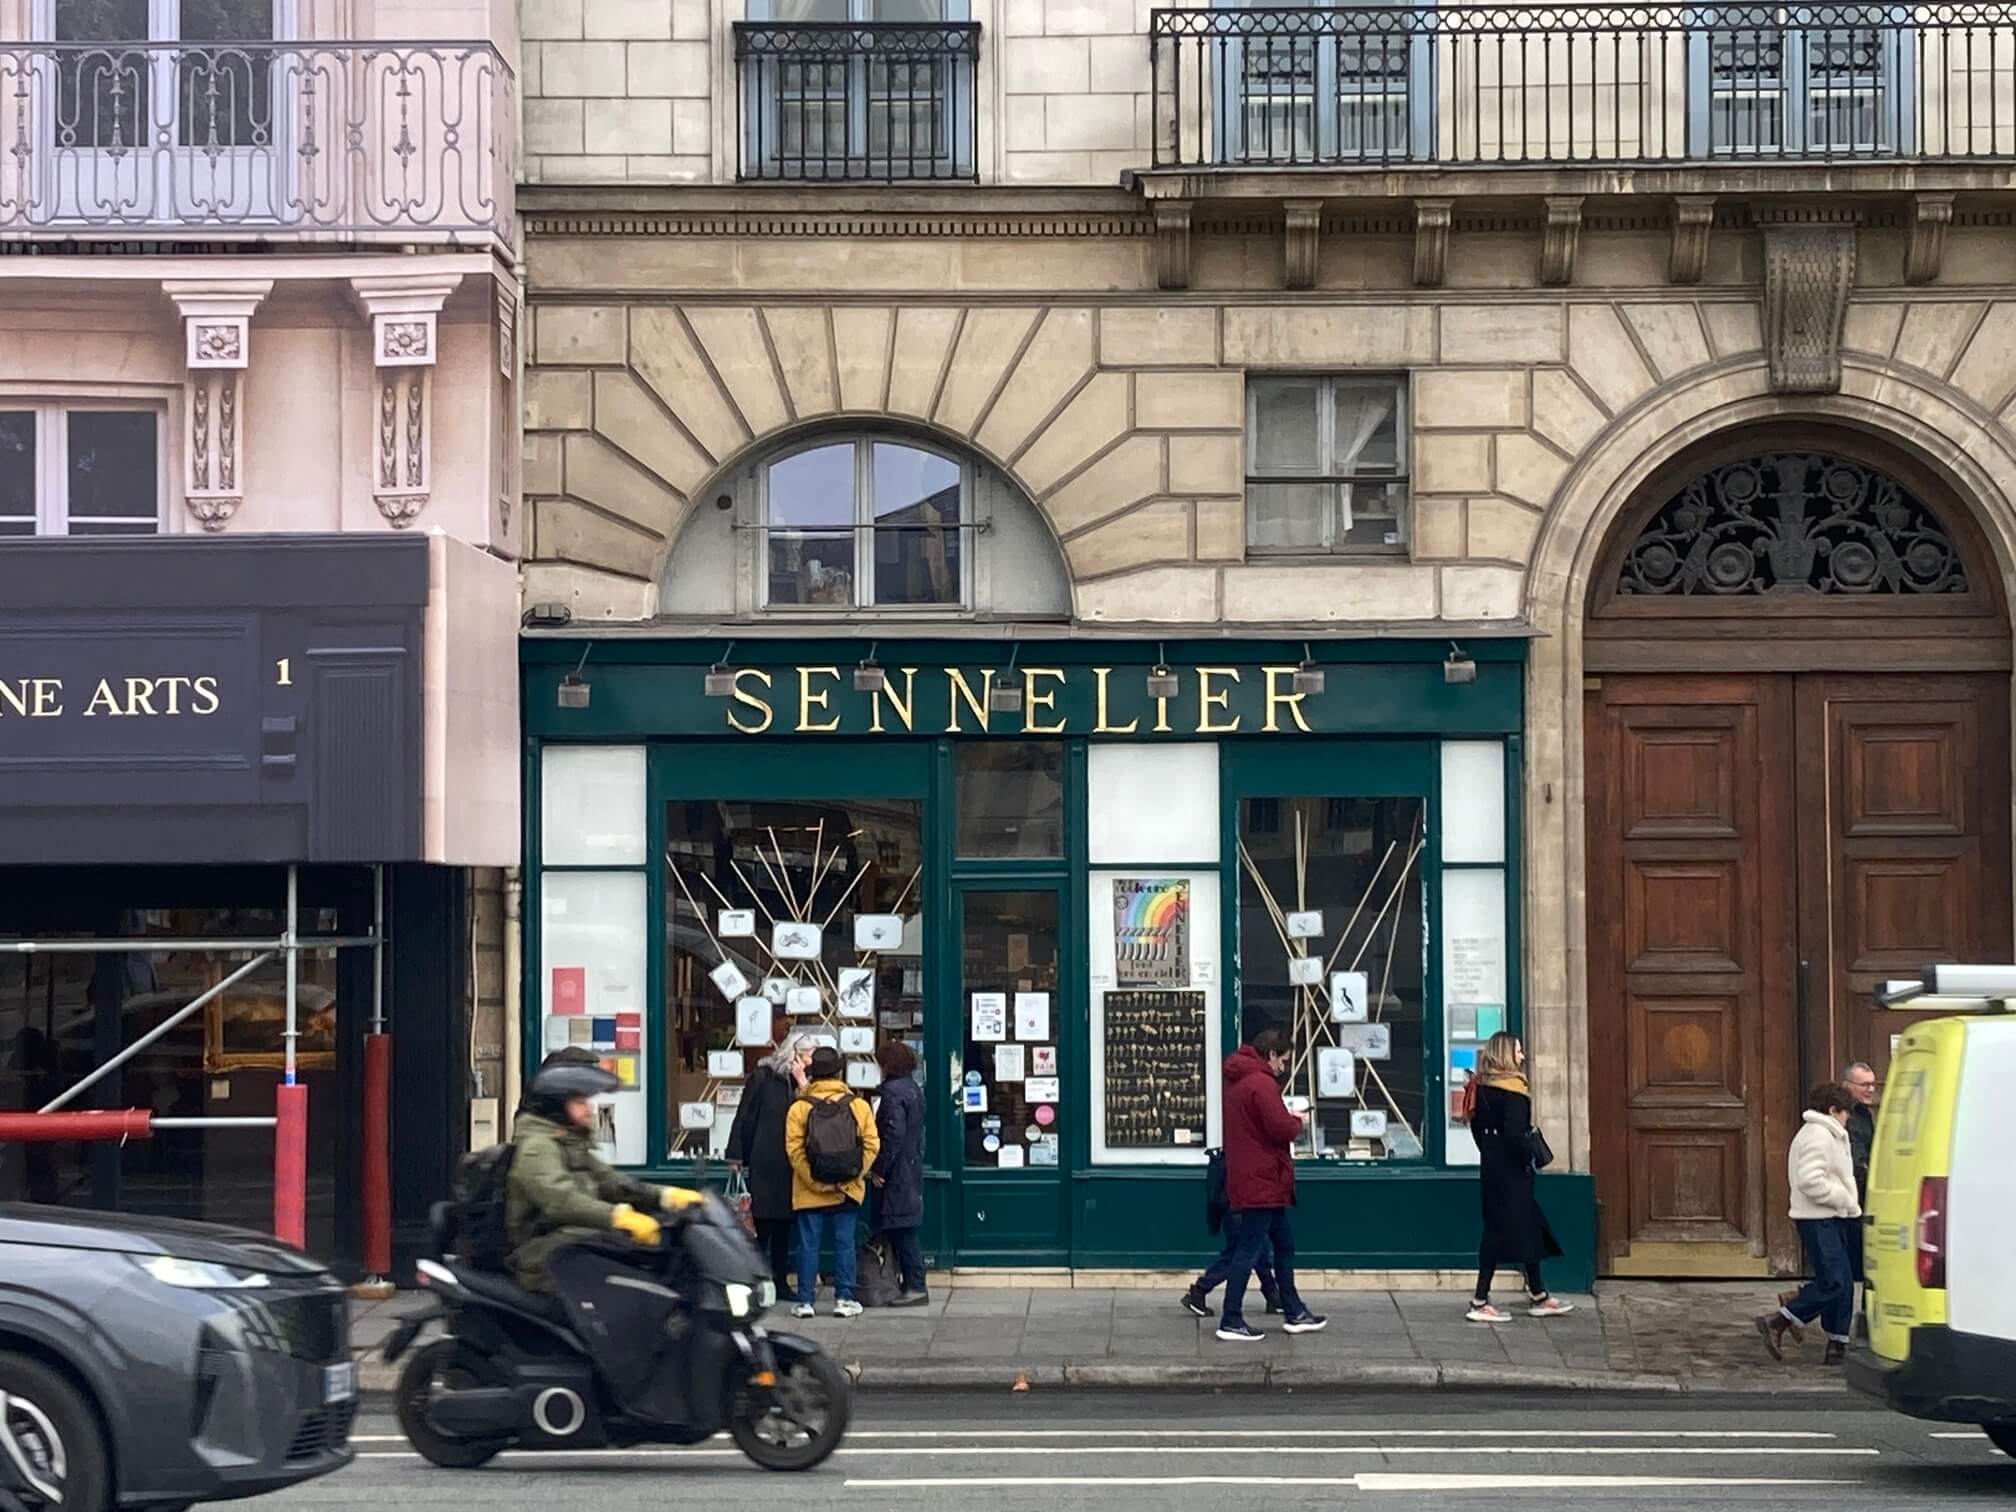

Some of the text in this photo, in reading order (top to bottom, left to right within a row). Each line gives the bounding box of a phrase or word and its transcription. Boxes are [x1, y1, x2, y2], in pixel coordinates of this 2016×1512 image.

[275, 658, 292, 685] 1
[83, 677, 220, 715] ARTS
[727, 665, 1312, 734] SENNELIER
